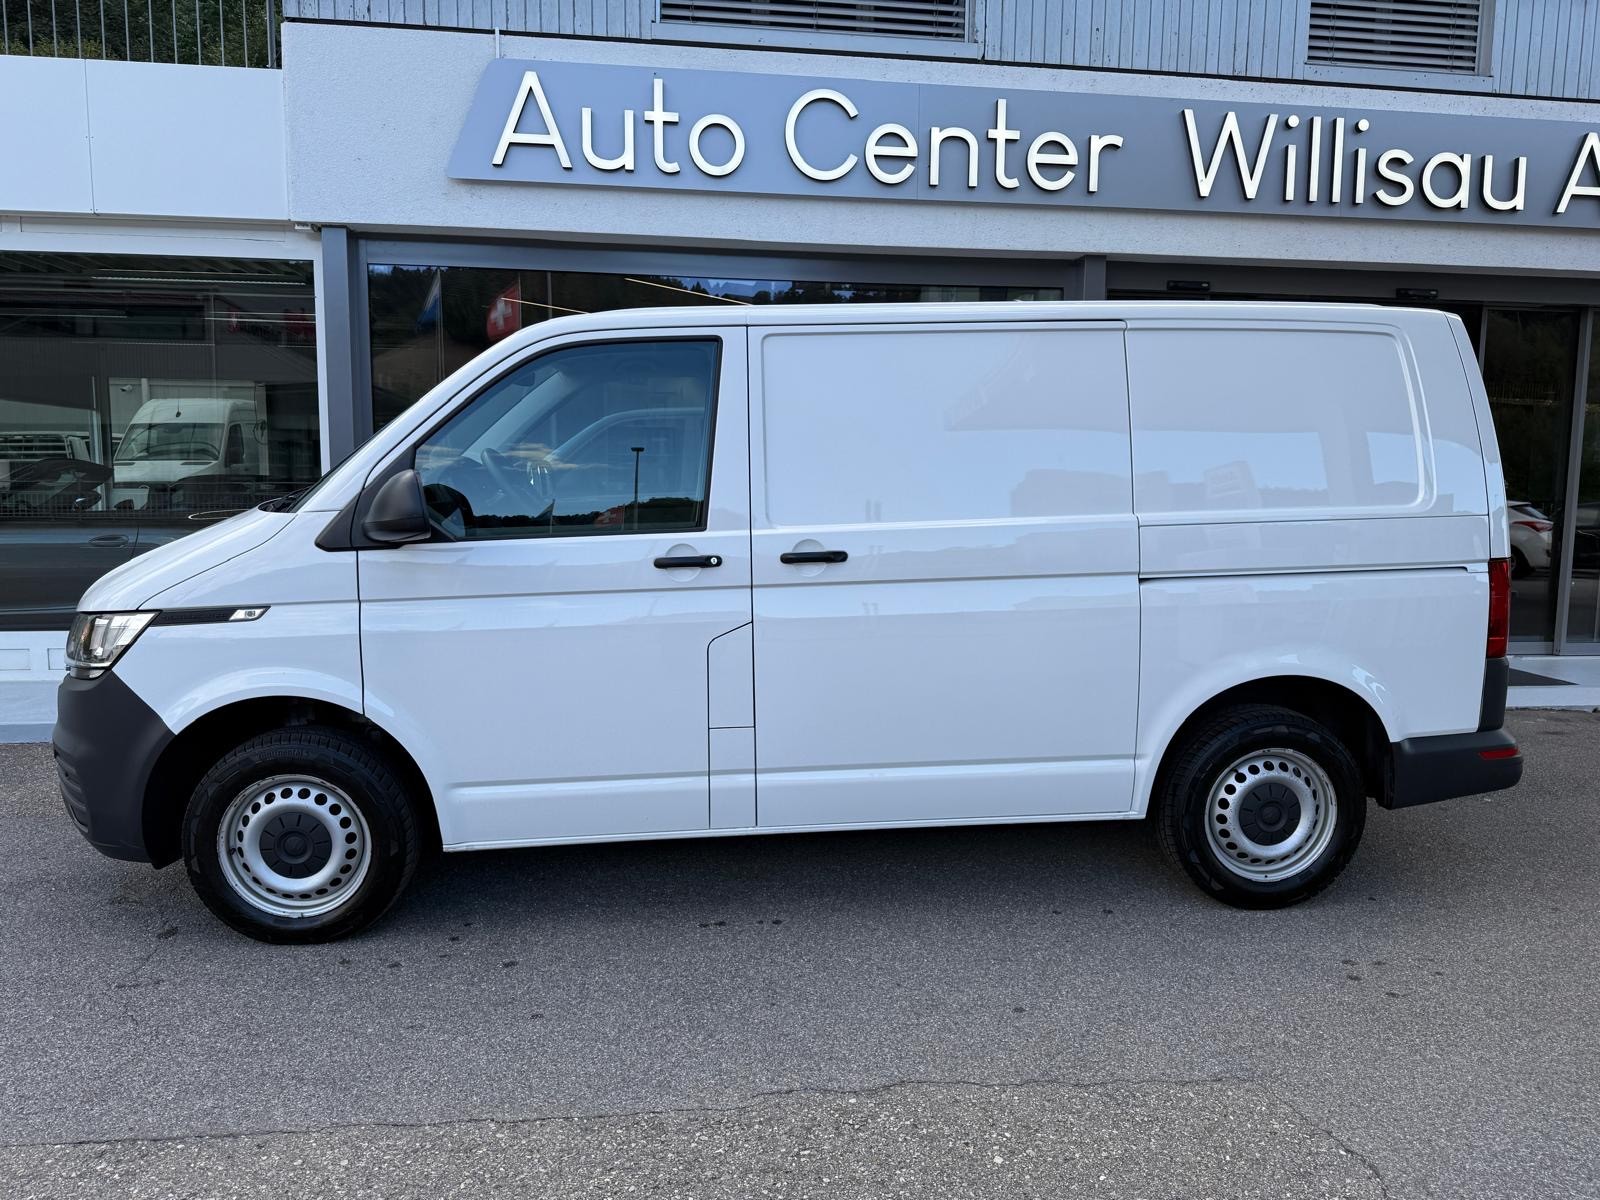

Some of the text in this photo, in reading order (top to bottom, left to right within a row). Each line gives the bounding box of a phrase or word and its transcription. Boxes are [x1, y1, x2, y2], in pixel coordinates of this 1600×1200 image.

[491, 70, 1600, 214] Auto Center Willisau A
